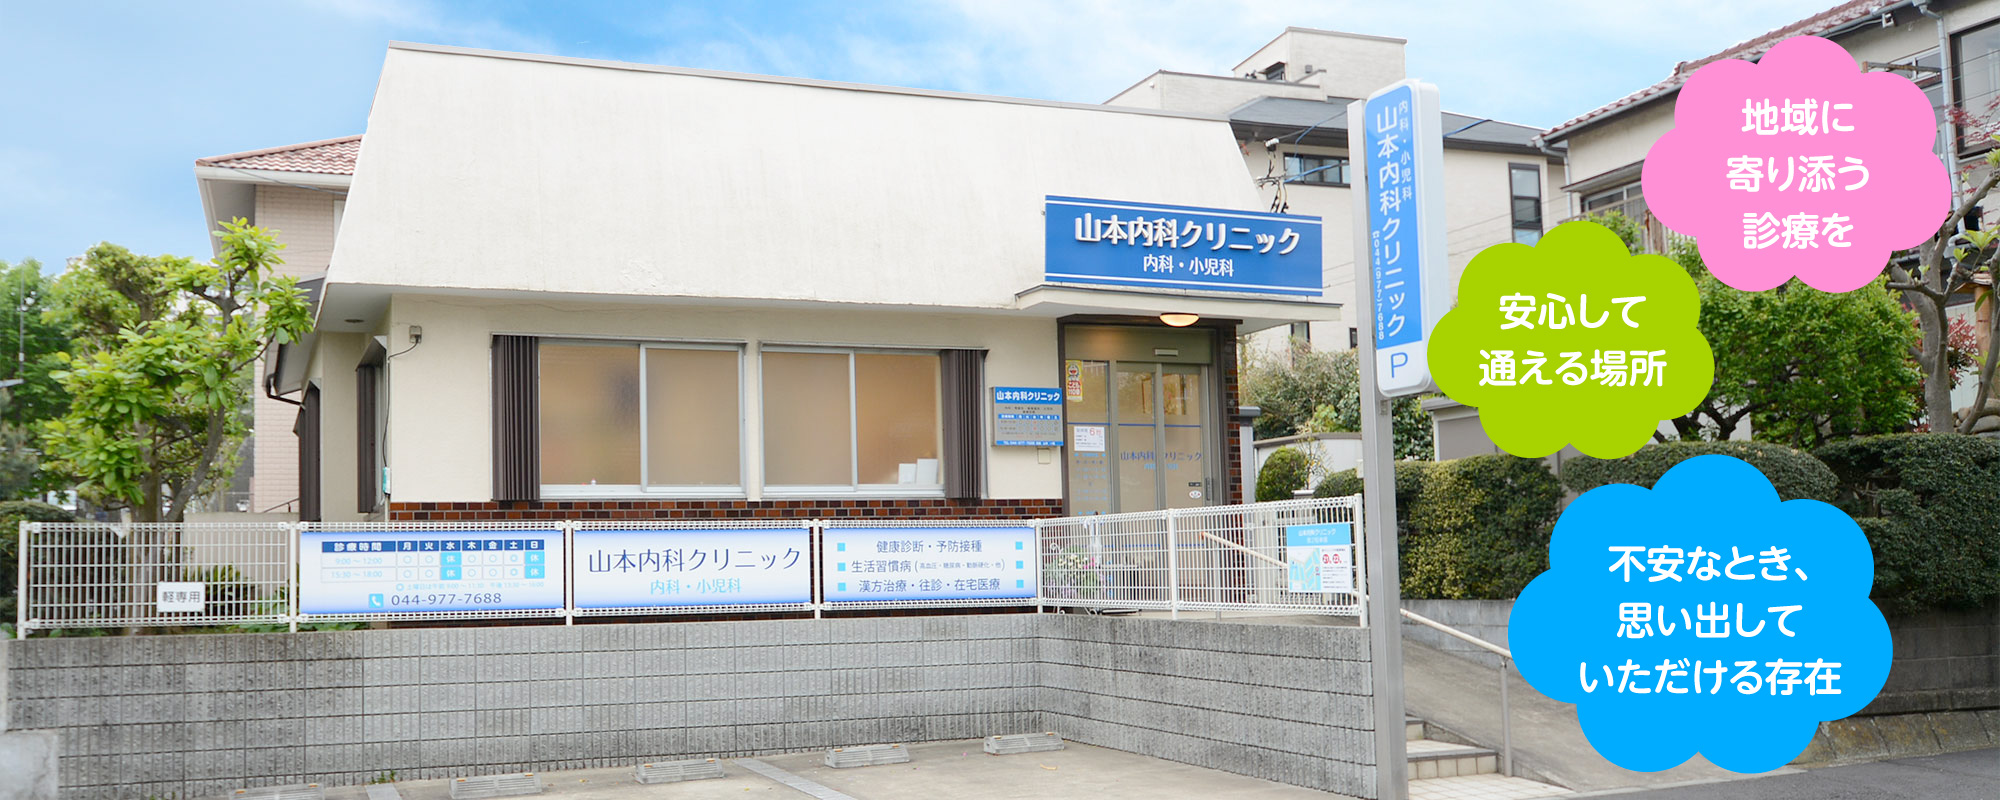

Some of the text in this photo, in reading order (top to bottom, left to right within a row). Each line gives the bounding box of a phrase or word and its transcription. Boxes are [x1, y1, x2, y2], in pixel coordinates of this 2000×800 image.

[1398, 101, 1412, 201] 内科・小児科
[1377, 106, 1405, 337] 山本内科クリニック
[1074, 212, 1300, 255] 山本内科クリニック
[1143, 254, 1234, 277] 内科・小児科
[1390, 352, 1408, 379] P
[996, 390, 1061, 402] 山本内科クリニック
[334, 540, 538, 552] 診療時間 月 火 水 木 金 土 日
[876, 540, 982, 553] 健康診断・予防接種
[530, 554, 539, 562] 休
[588, 548, 801, 573] 山本内科クリニック
[530, 568, 539, 576] 休
[650, 578, 742, 595] 内科・小児科
[859, 578, 1000, 593] 漢方治療・往診・在宅医療
[163, 591, 200, 603] 軽専用
[391, 593, 502, 605] 044-977-7688
